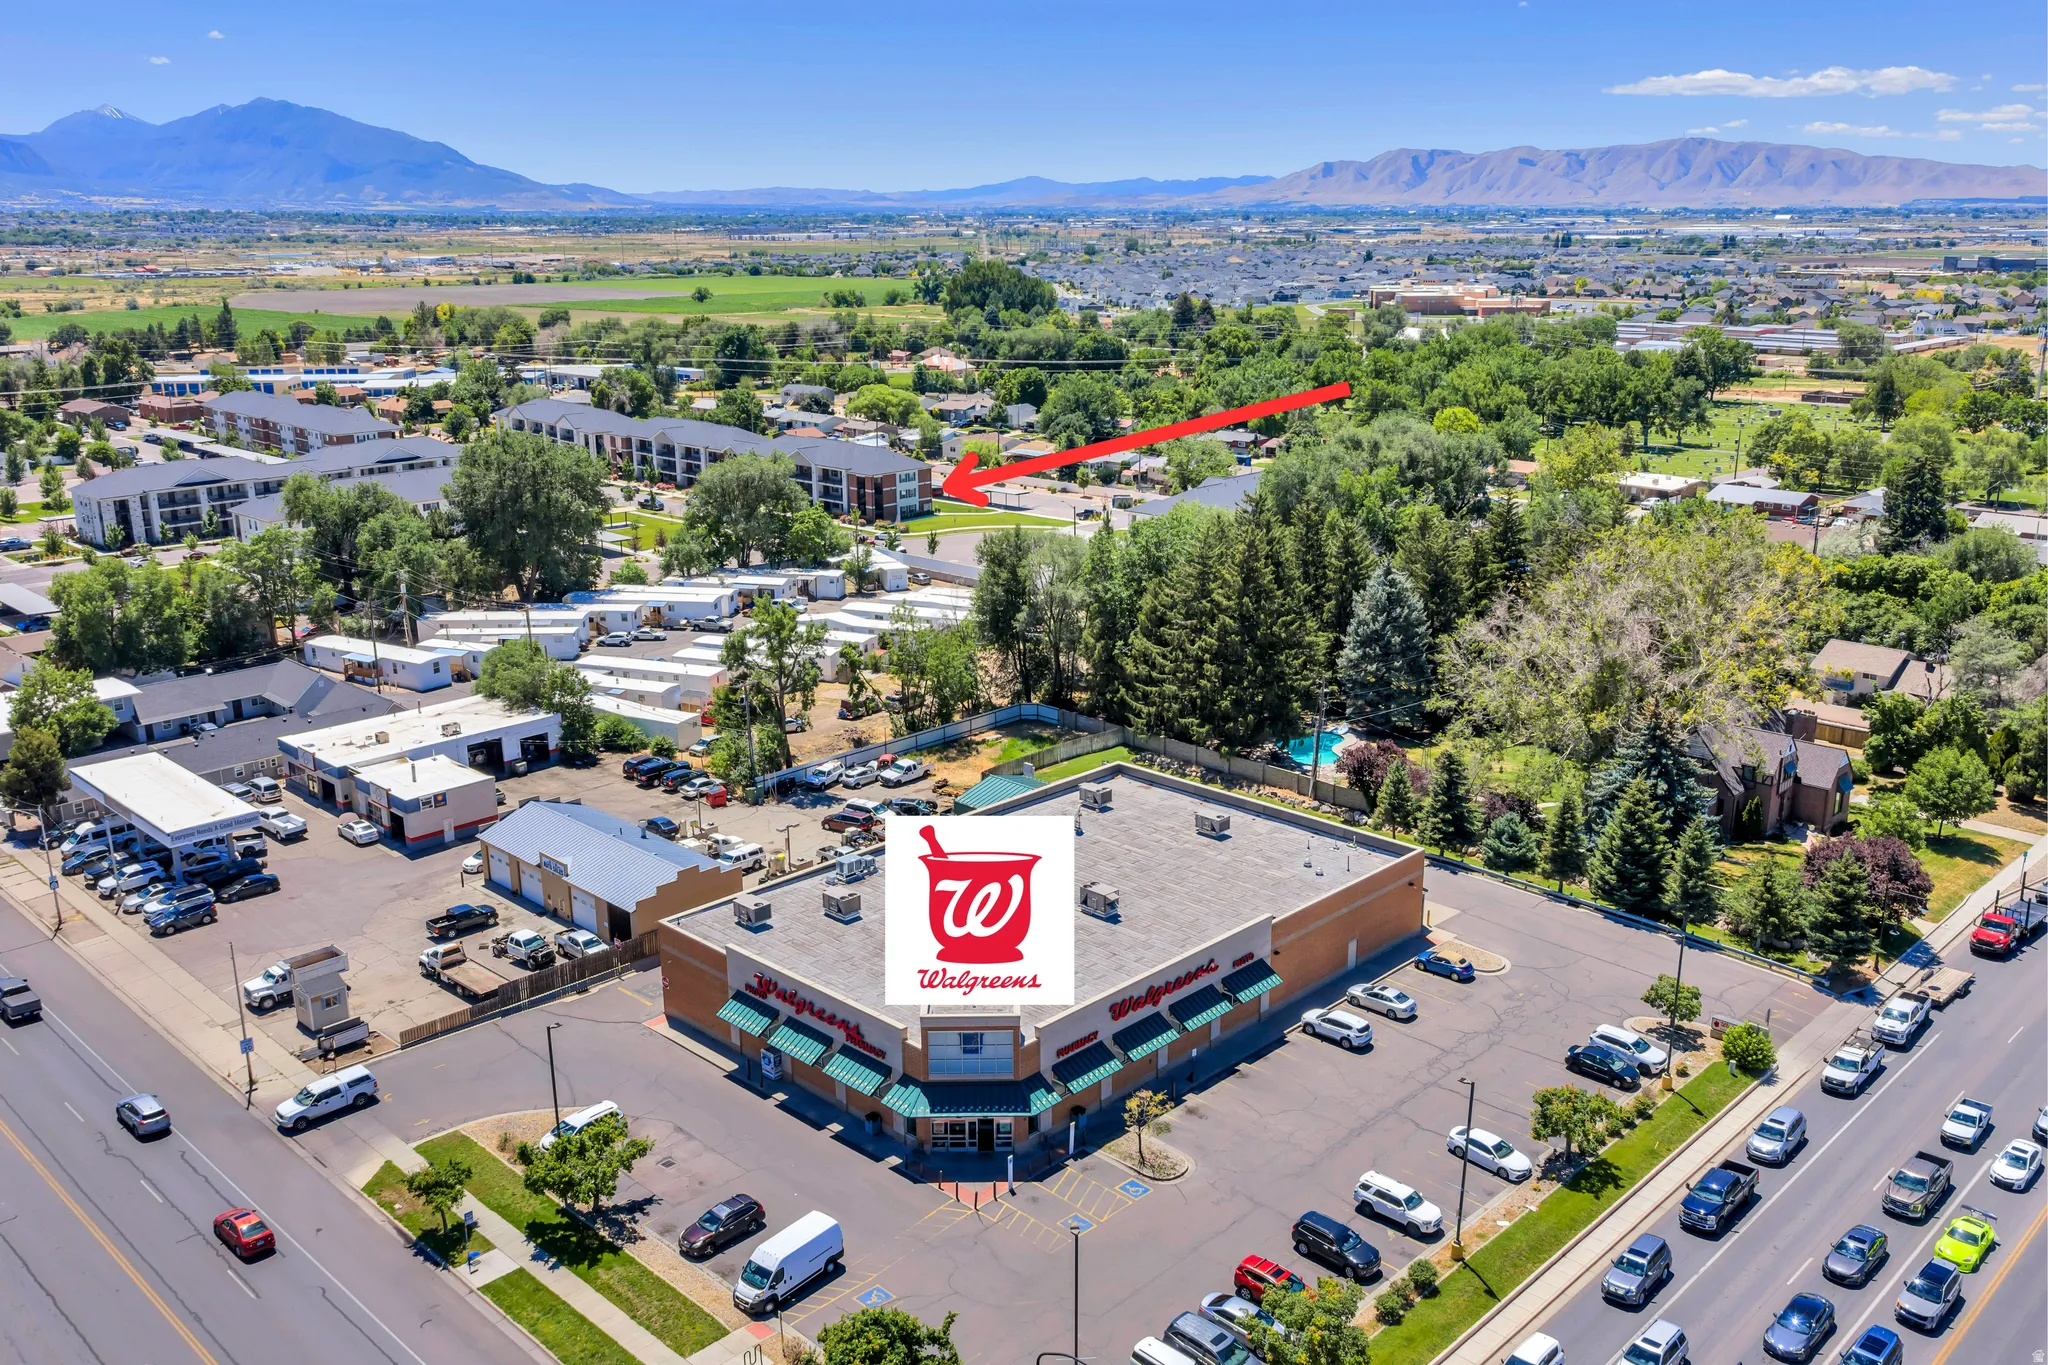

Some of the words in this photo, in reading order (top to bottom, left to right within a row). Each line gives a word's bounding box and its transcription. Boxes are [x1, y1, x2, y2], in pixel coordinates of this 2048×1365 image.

[171, 831, 196, 841] Everyone
[196, 825, 214, 835] Needs
[220, 821, 234, 830] Good
[234, 815, 259, 826] Mechanic
[753, 972, 864, 1041] Walgreens
[1109, 958, 1220, 1021] Walgreens
[1056, 1030, 1099, 1059] PHARMACY
